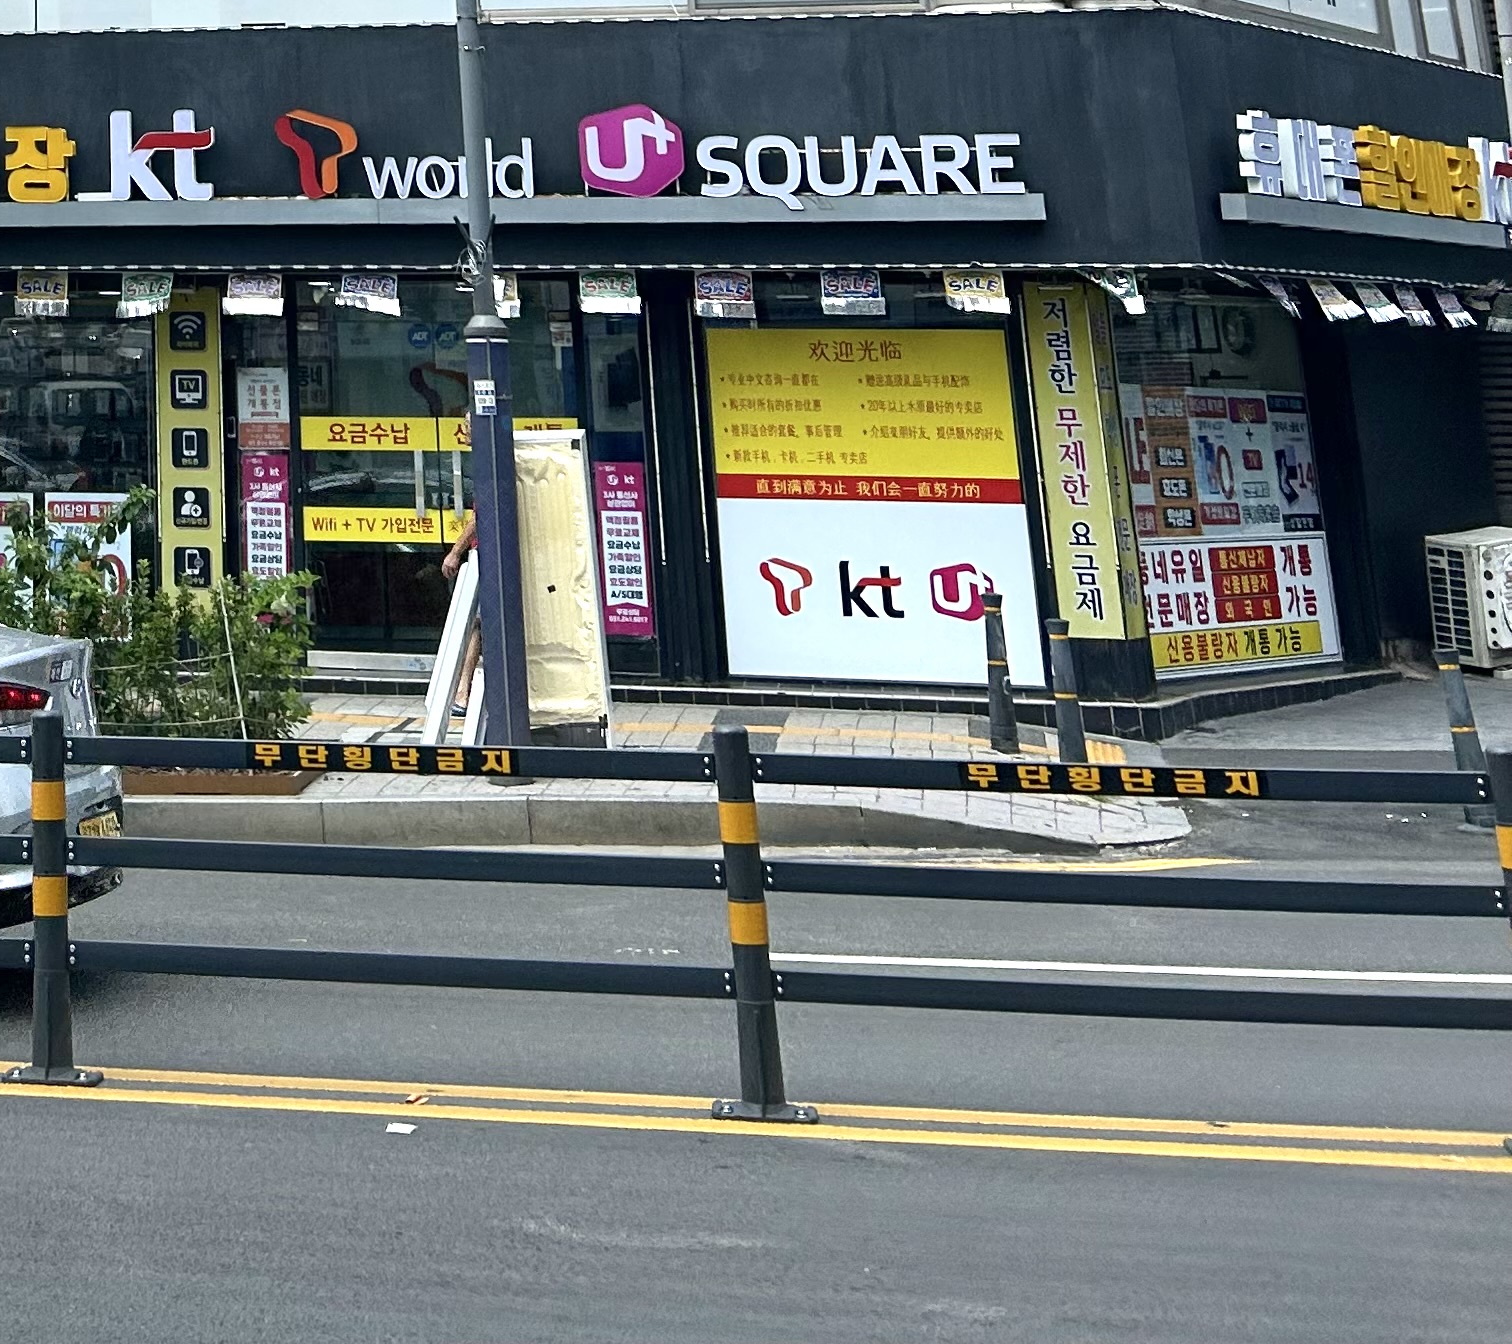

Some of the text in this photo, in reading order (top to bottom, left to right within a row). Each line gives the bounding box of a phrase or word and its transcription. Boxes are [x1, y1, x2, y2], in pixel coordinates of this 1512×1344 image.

[108, 109, 215, 202] kt
[697, 132, 1026, 211] SQUARE
[20, 279, 64, 297] SALE
[698, 278, 748, 296] SALE
[947, 276, 998, 293] SALE
[808, 339, 903, 364] 欢迎光临
[181, 380, 196, 391] TV
[328, 422, 410, 445] 요금수납
[1042, 297, 1105, 622] 저렴한 무제한 요금제
[311, 516, 338, 533] Wifi
[356, 517, 377, 533] TV
[381, 514, 435, 534] 가입전문
[838, 560, 906, 619] kt
[1285, 583, 1318, 618] 가능
[1275, 625, 1303, 654] 가능
[254, 743, 514, 775] 무단횡단금지
[966, 762, 1261, 798] 무단횡단금지
